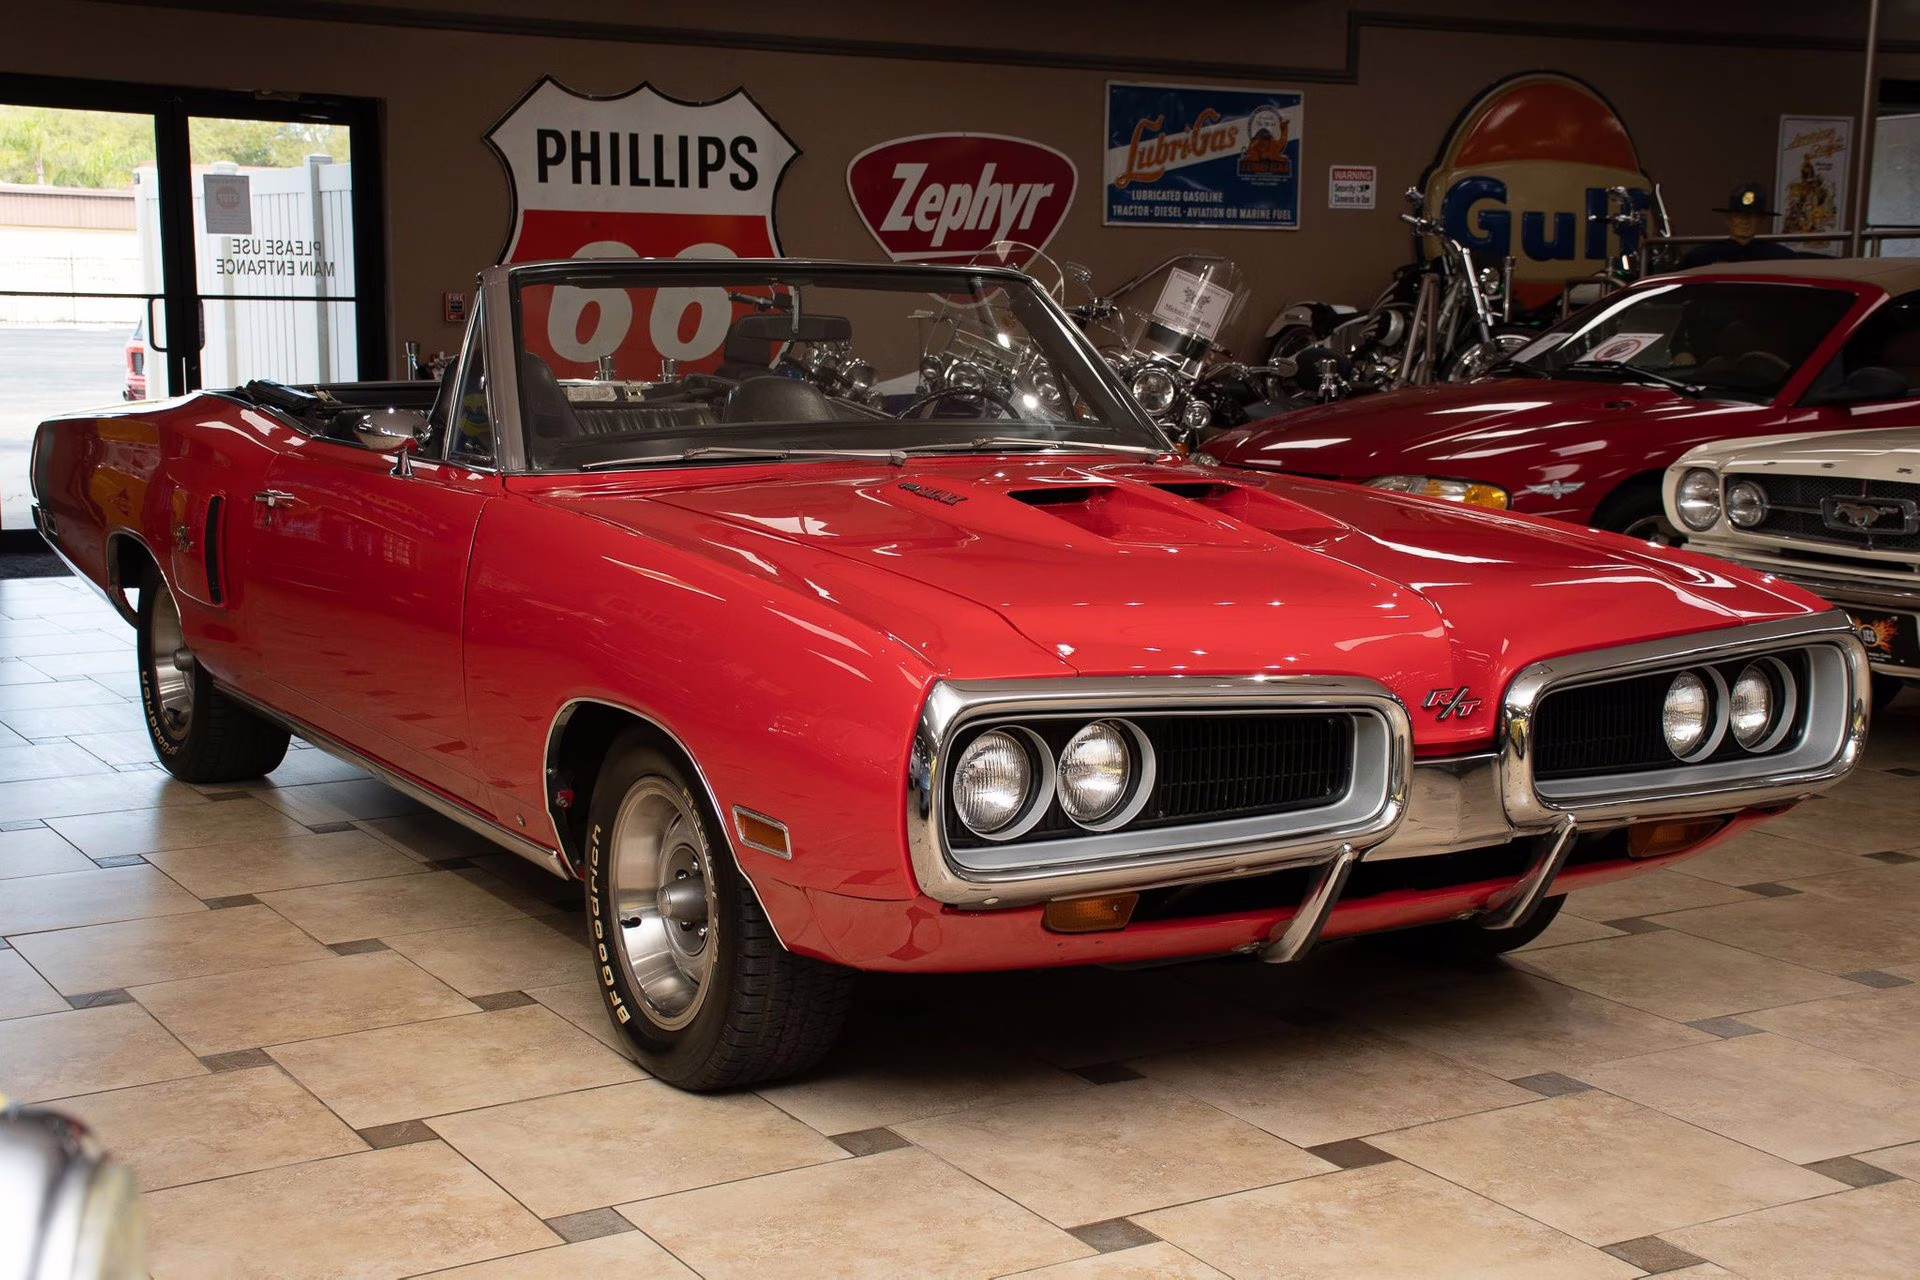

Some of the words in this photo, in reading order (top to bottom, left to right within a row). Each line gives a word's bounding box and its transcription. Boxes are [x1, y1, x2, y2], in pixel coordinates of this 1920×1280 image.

[537, 129, 758, 191] PHILLIPS
[1333, 169, 1372, 181] WARNING
[1131, 189, 1182, 202] LUBRICATED
[1183, 190, 1224, 203] GASOLINE
[1334, 183, 1355, 193] Security
[879, 162, 1055, 263] Zephyr
[1187, 207, 1225, 218] AVIATION
[1226, 208, 1237, 219] OR
[1239, 208, 1271, 220] MARINE
[1273, 209, 1292, 220] FUEL
[1441, 176, 1652, 264] Gulf
[547, 241, 738, 362] 66
[1421, 686, 1482, 721] R/T
[589, 823, 631, 1025] BFGoodrich
